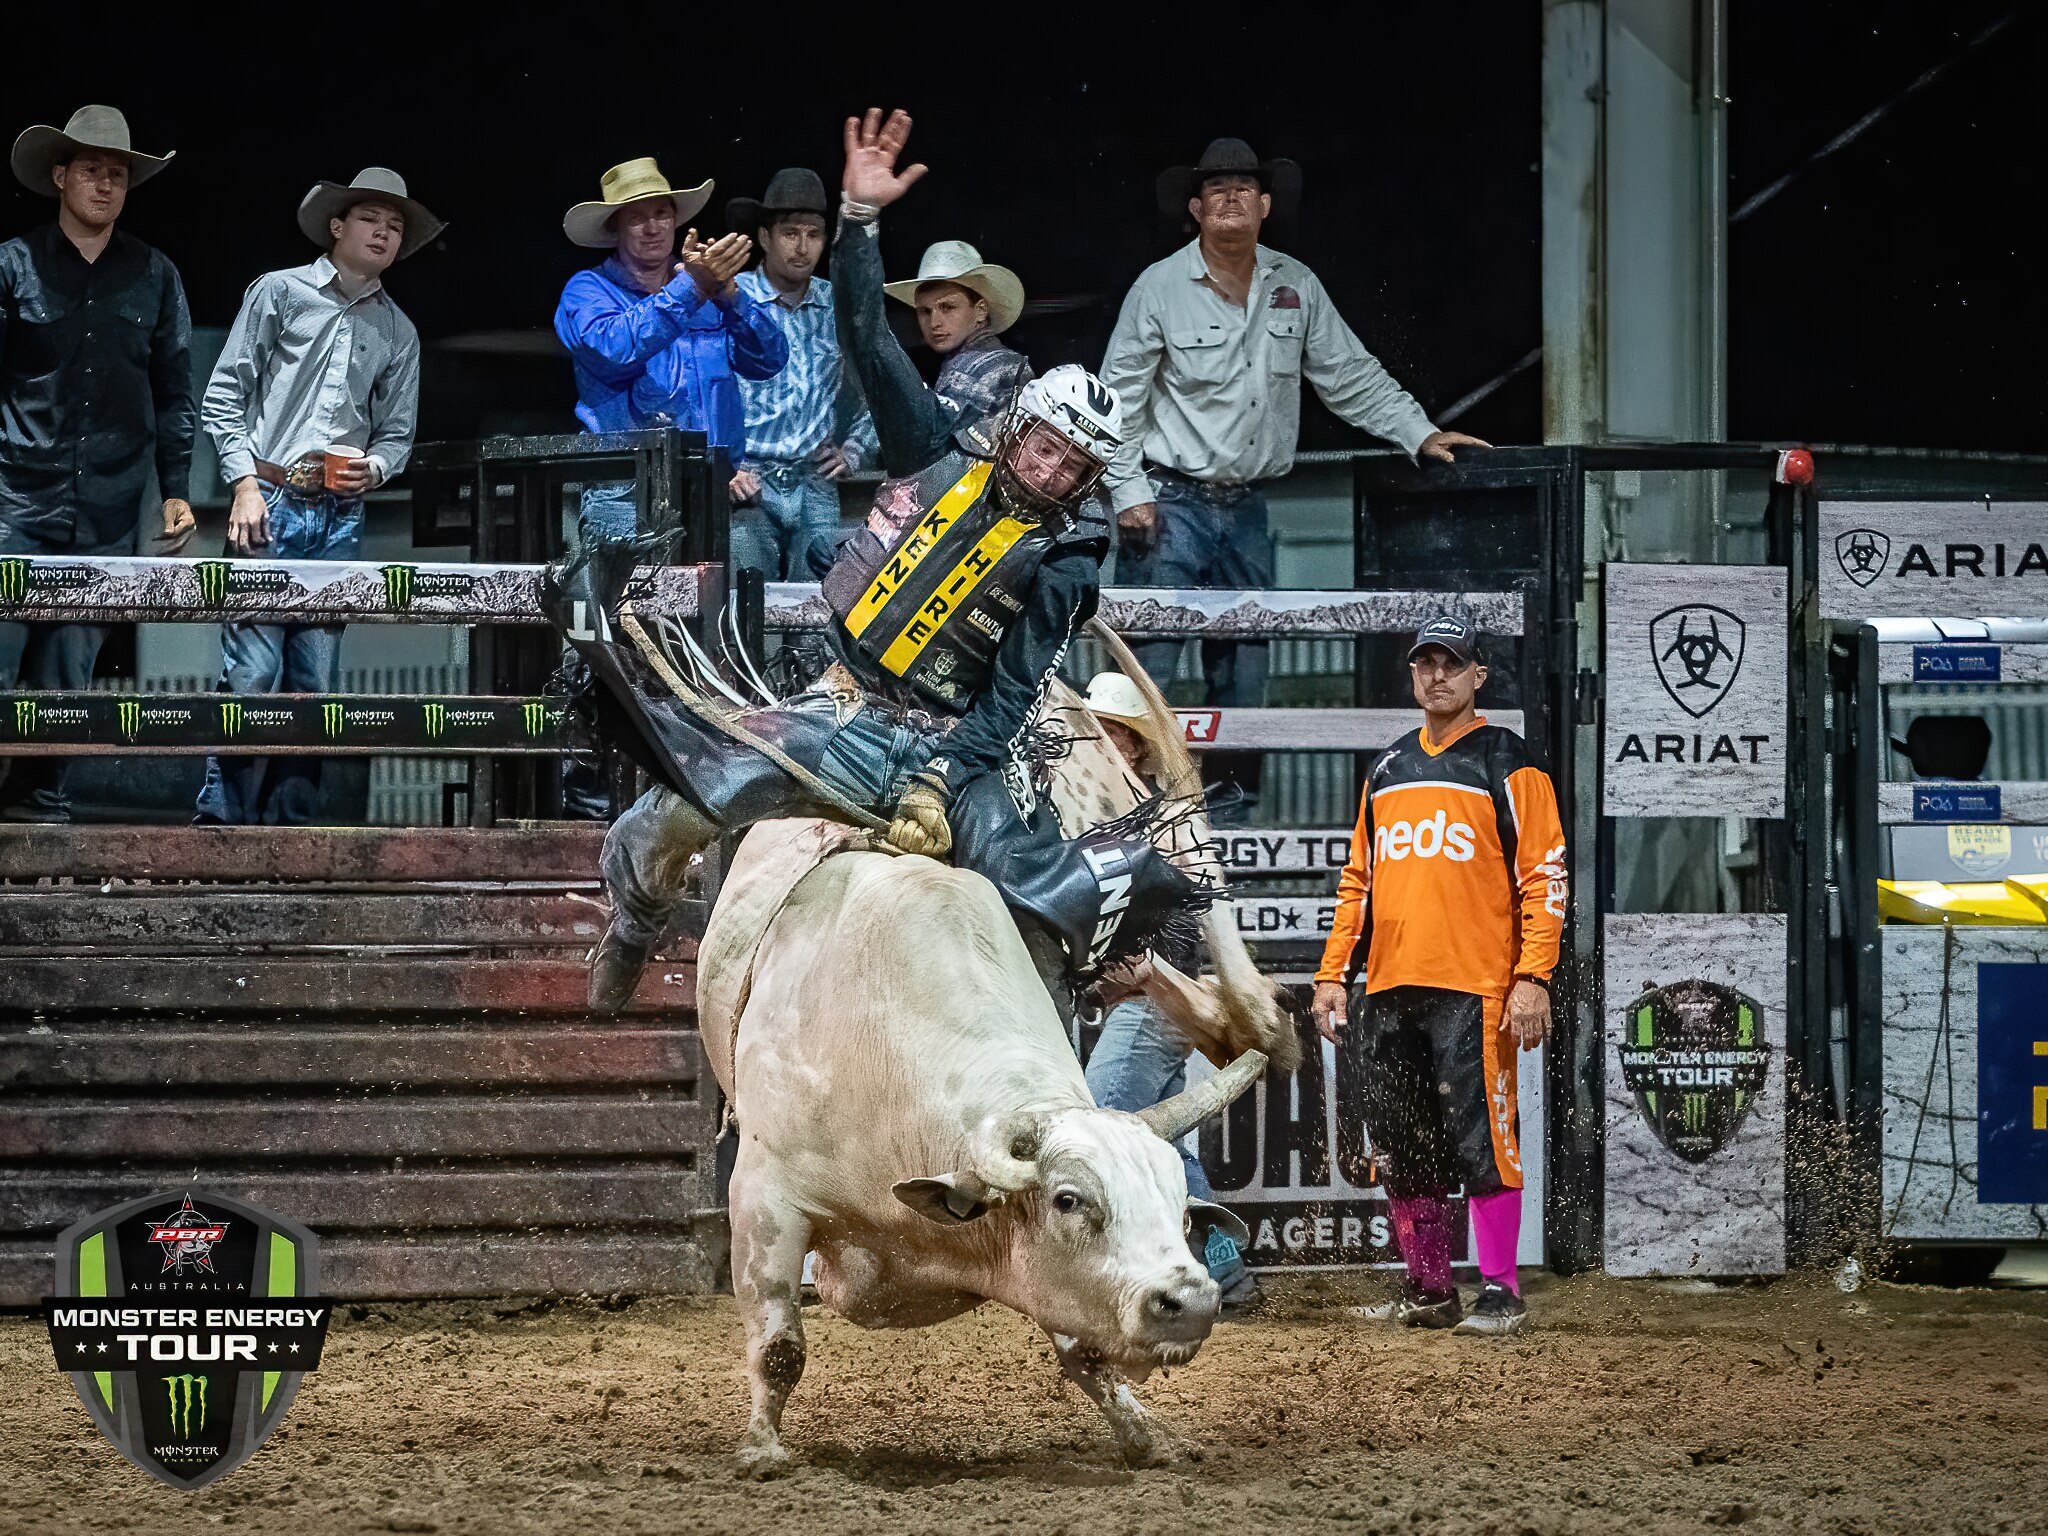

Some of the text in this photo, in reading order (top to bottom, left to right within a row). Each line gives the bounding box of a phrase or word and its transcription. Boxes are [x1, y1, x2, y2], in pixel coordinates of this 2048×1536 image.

[870, 509, 950, 605] KENT
[1895, 543, 2048, 577] ARIA
[905, 547, 993, 646] HIRE
[1614, 733, 1770, 763] ARIAT
[1374, 809, 1476, 866] neds
[1657, 1067, 1734, 1086] TOUR
